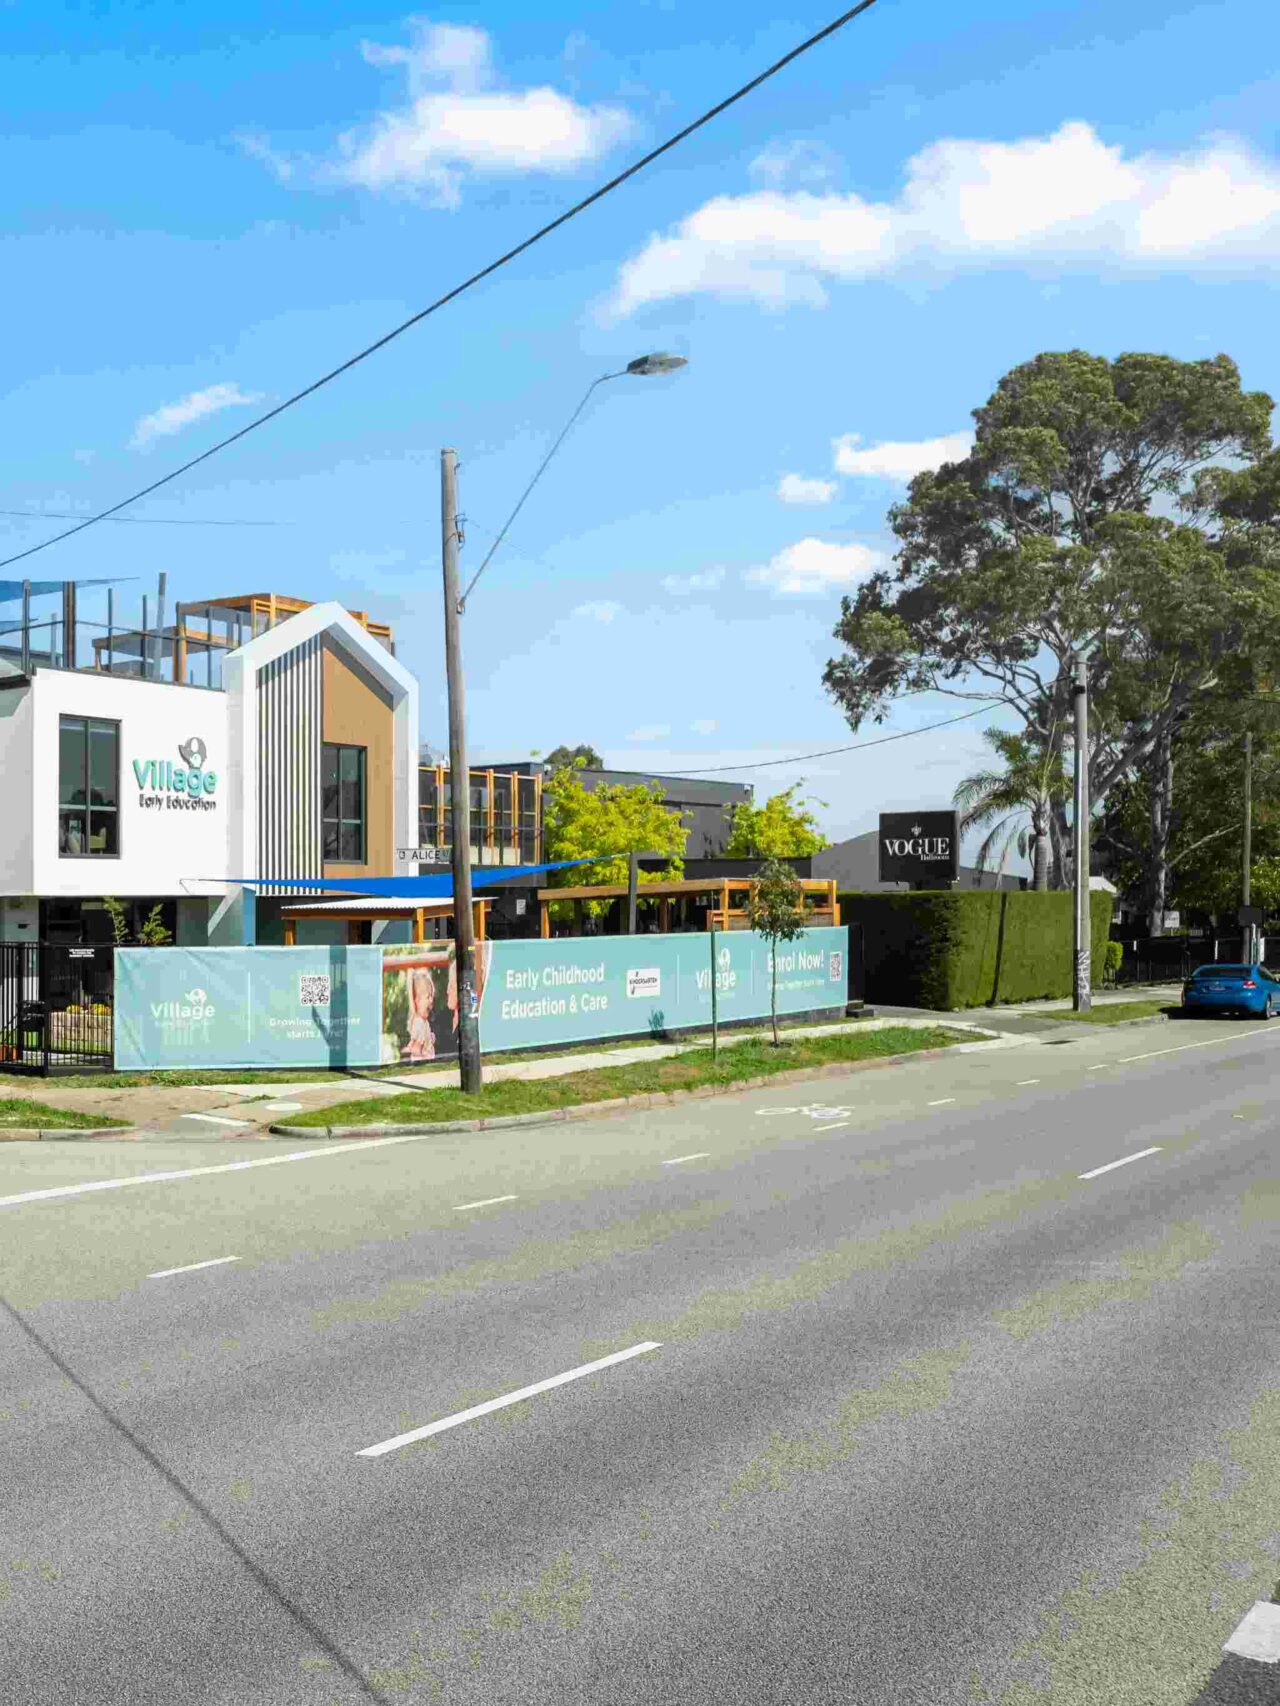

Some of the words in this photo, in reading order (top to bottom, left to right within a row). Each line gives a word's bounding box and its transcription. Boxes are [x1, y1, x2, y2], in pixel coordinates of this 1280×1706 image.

[132, 758, 217, 800] Village
[139, 793, 164, 811] Early
[166, 795, 217, 812] Education
[411, 850, 441, 860] ALICE
[885, 837, 950, 856] VOGUE
[767, 951, 796, 973] Enrol
[798, 949, 824, 971] Now!
[506, 967, 539, 991] Early
[542, 962, 605, 986] Childhood
[695, 969, 736, 991] Vilage
[149, 1000, 216, 1020] Village
[501, 996, 566, 1019] Education
[569, 994, 578, 1013] &
[581, 993, 608, 1013] Care
